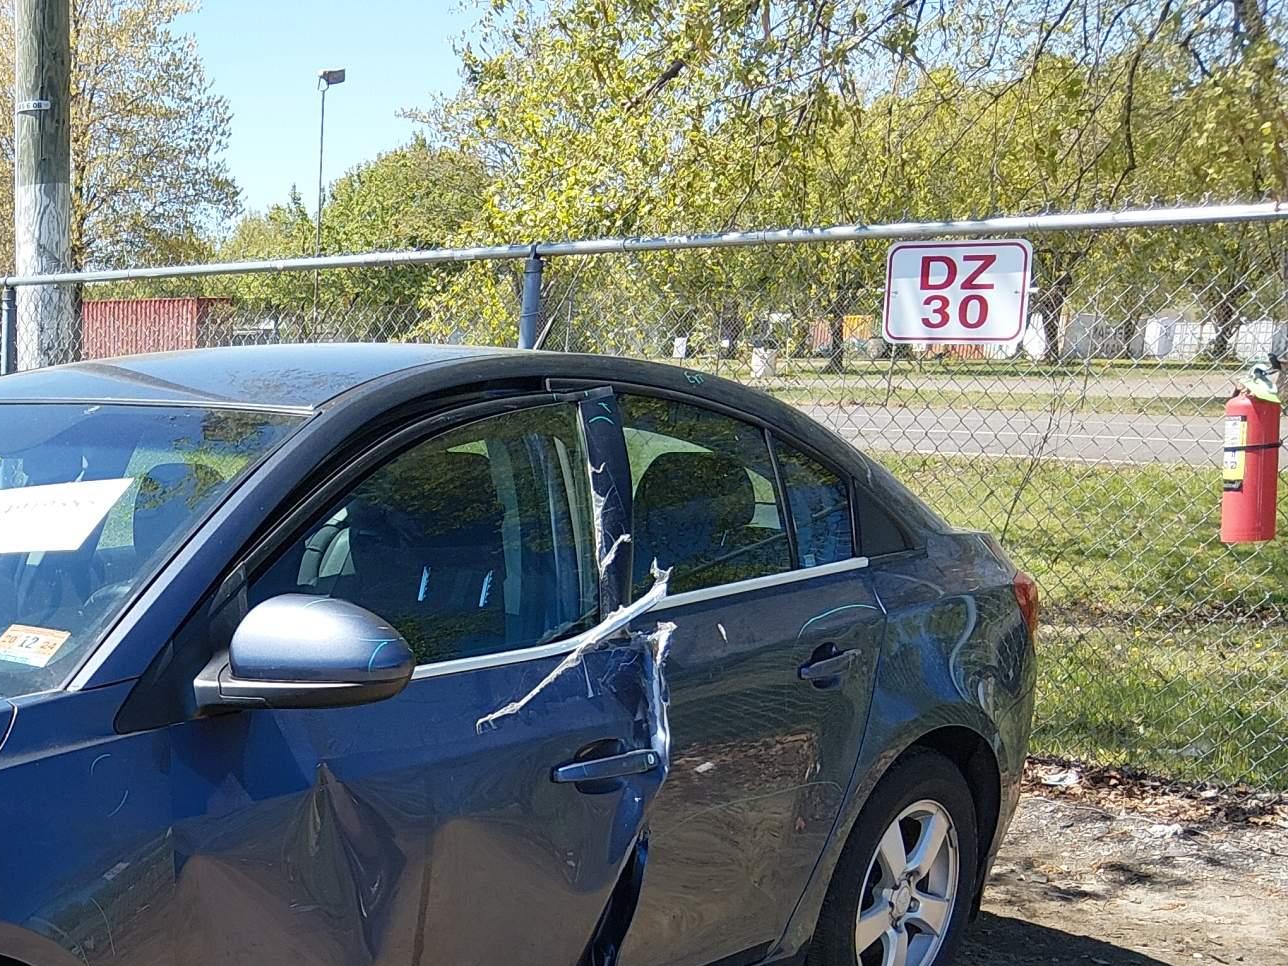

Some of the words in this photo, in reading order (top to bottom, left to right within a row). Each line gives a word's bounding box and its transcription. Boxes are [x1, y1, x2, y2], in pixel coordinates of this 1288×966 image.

[919, 254, 997, 290] DZ
[921, 294, 989, 329] 30
[18, 635, 40, 649] 12
